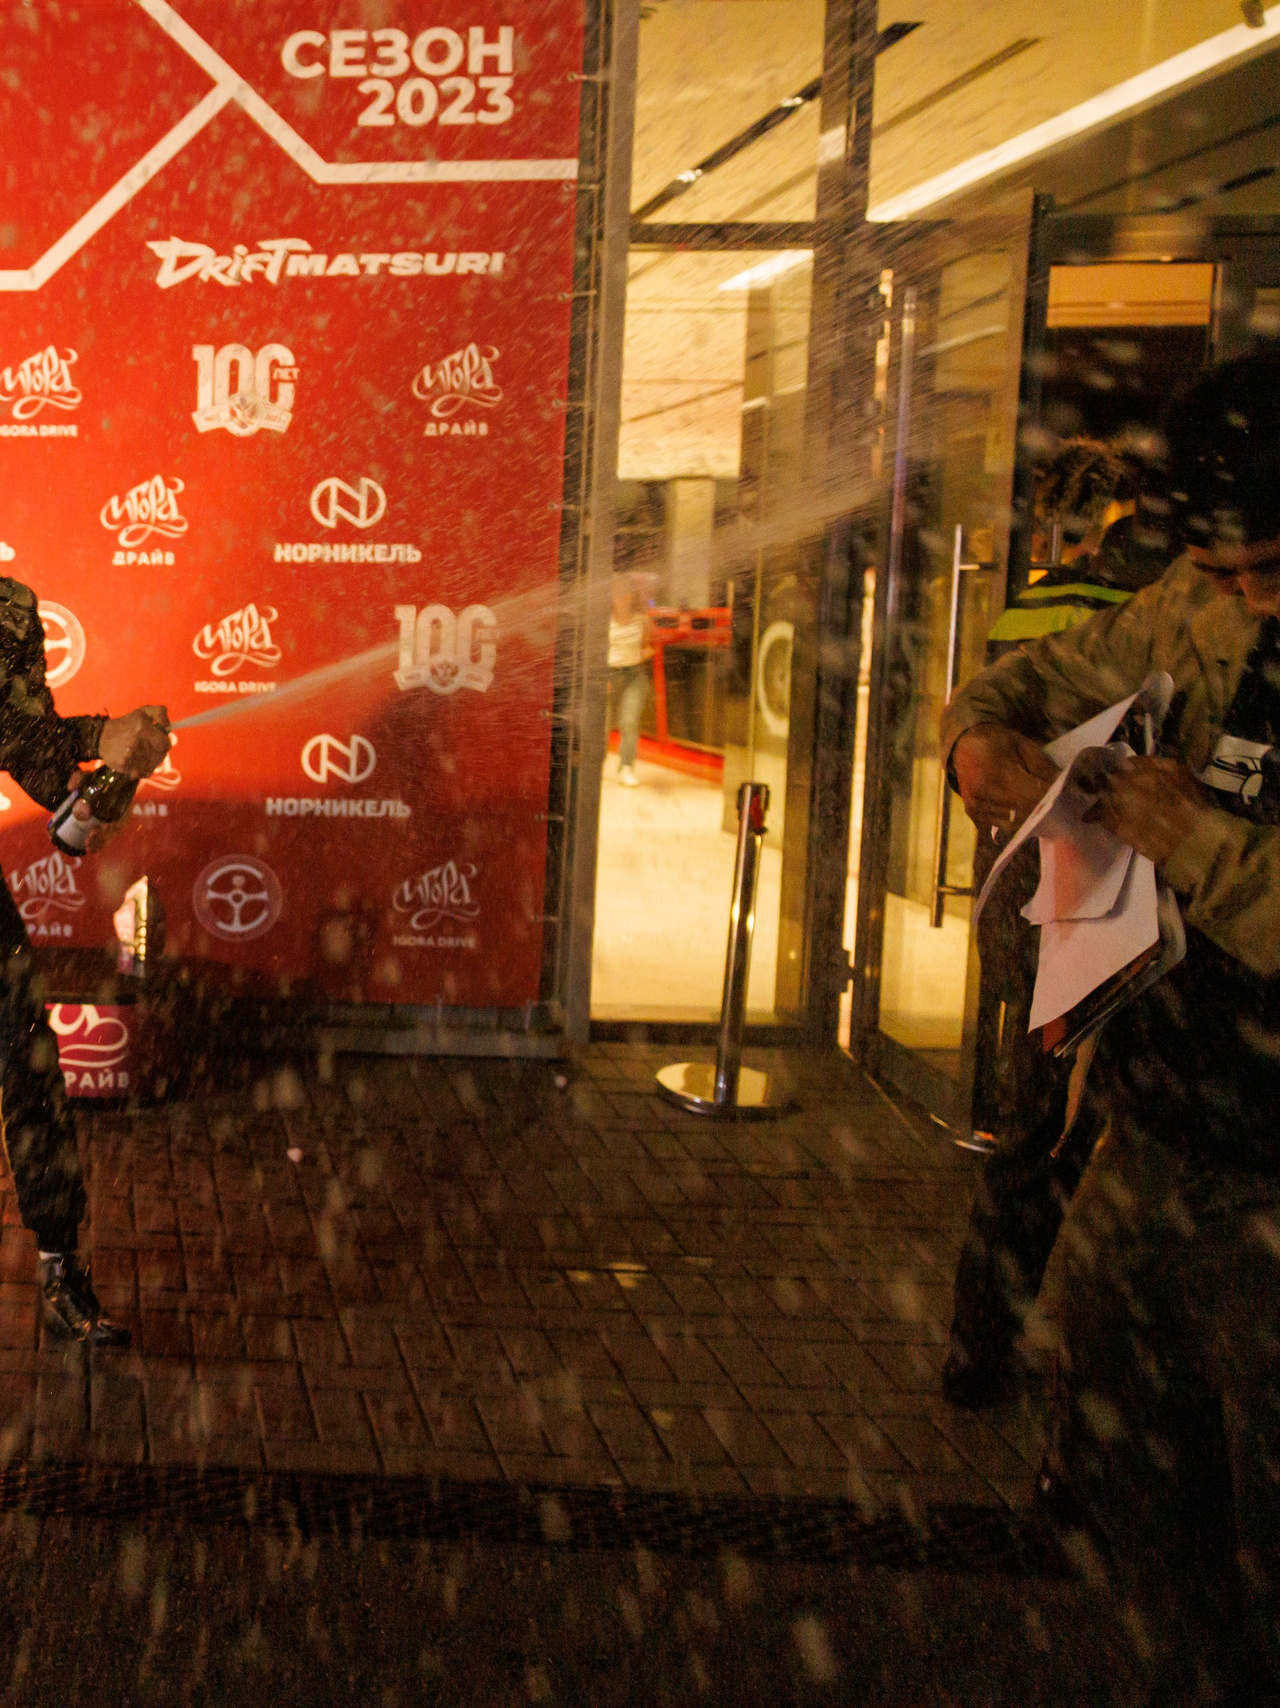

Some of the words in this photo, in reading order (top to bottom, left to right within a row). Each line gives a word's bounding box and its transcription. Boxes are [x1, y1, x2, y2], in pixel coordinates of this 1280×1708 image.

[280, 25, 515, 79] СЕЗОН
[357, 75, 516, 127] 2023
[273, 542, 423, 564] НОРНИКЕЛЬ
[265, 797, 411, 818] НОРНИКЕЛЬ
[26, 922, 73, 937] РАЙВ
[63, 1068, 131, 1089] РАЙВ
